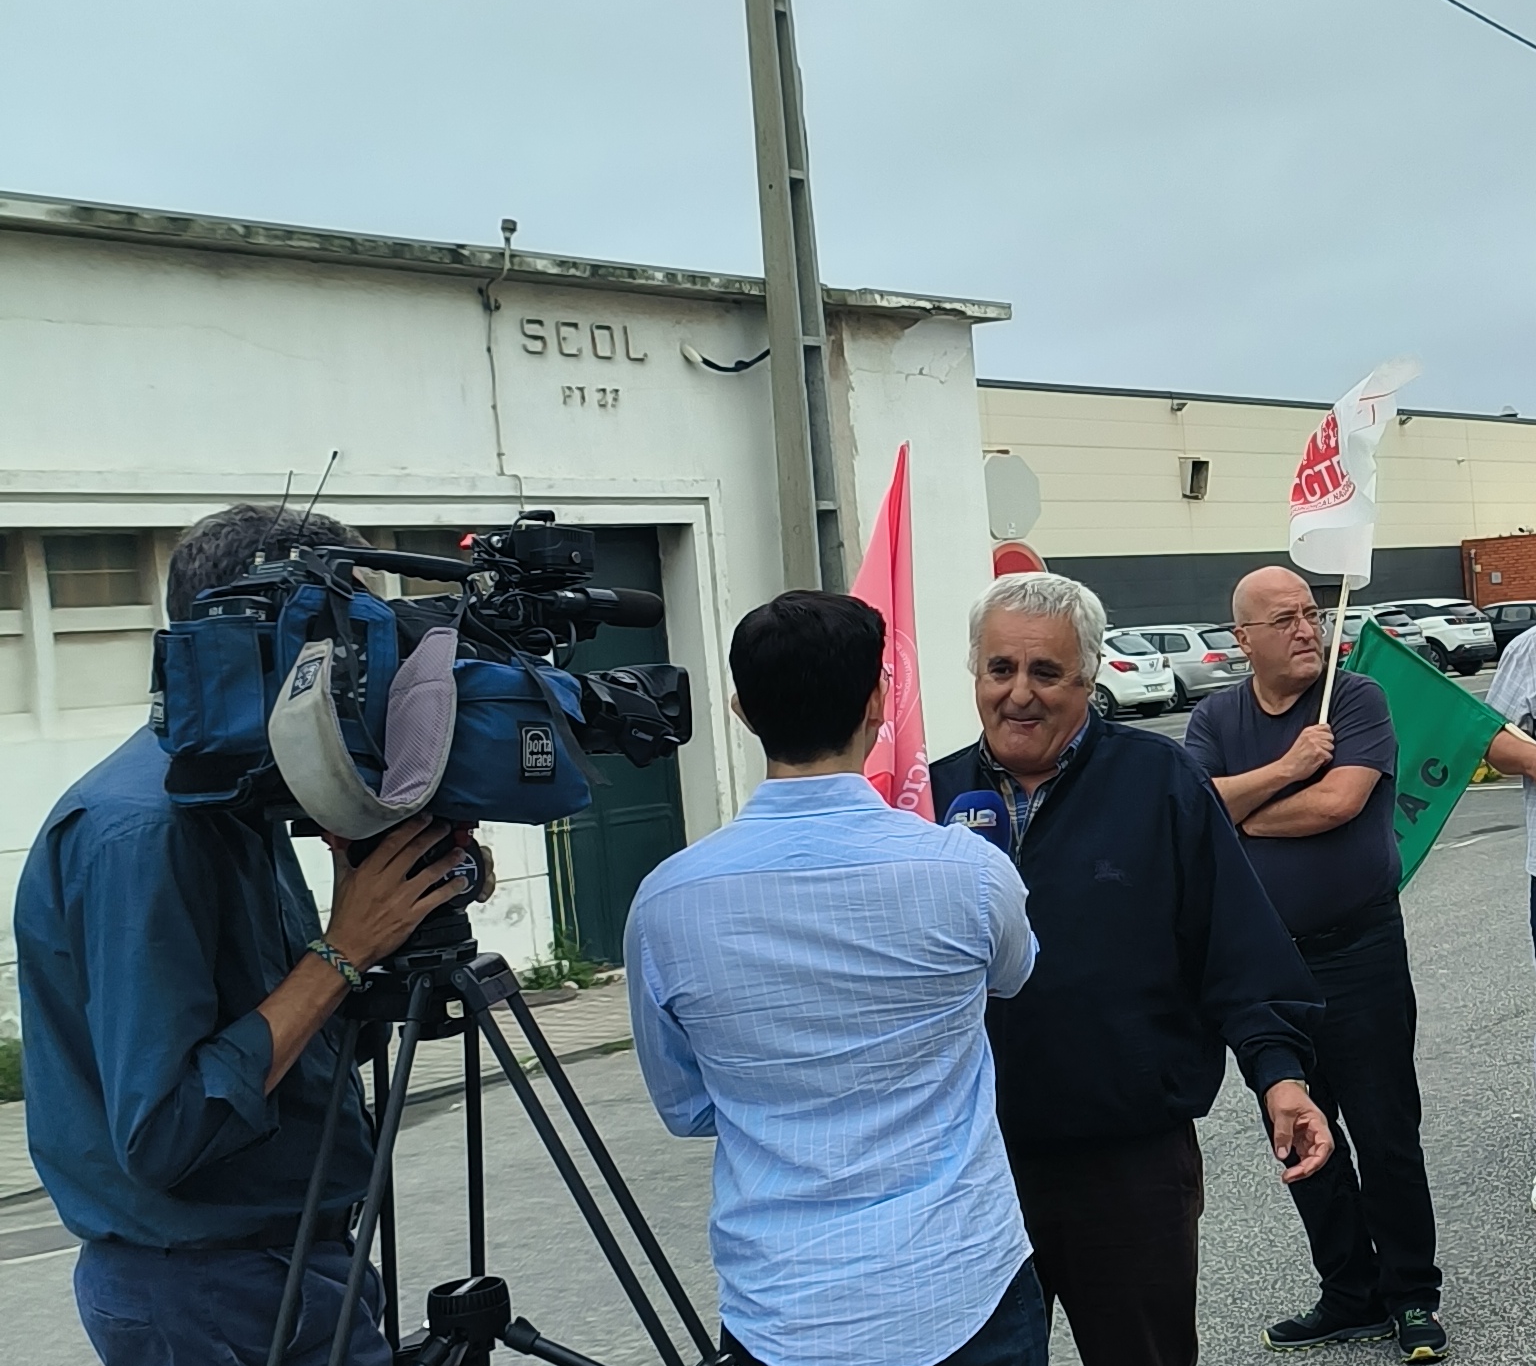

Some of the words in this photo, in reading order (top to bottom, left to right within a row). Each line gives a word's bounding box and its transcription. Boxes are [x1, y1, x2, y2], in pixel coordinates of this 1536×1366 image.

[561, 385, 586, 407] PT
[526, 753, 552, 767] brace
[1394, 757, 1449, 843] AC
